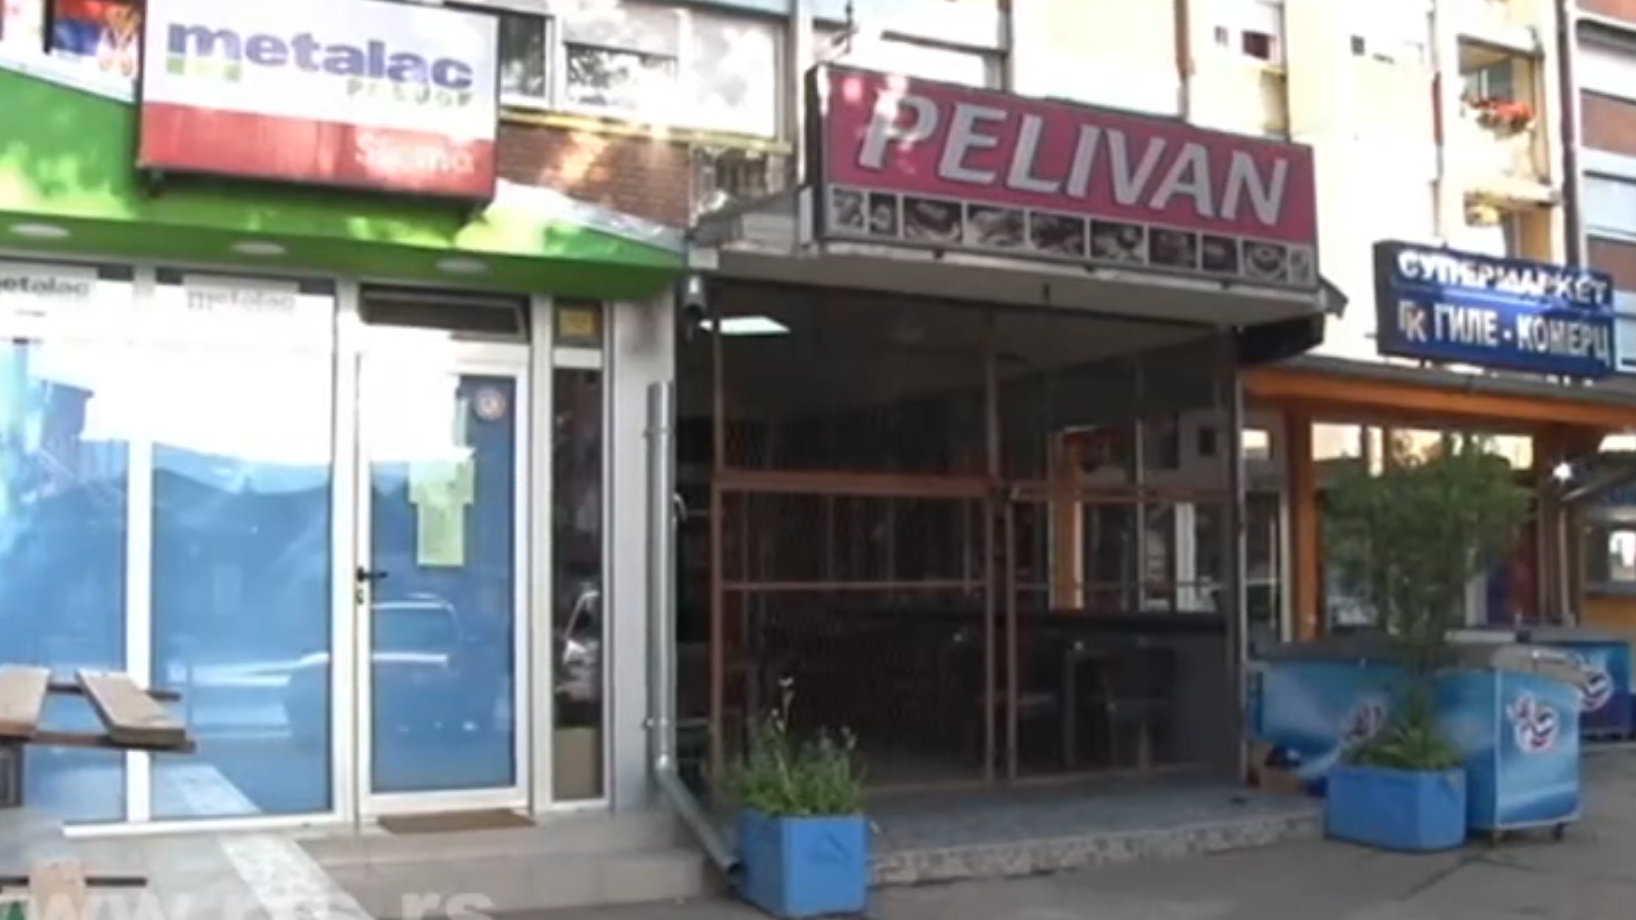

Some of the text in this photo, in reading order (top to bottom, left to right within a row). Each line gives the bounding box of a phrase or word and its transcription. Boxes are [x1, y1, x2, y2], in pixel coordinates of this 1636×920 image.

[167, 22, 474, 90] metalac
[858, 95, 1288, 226] PELIVAN
[0, 274, 90, 297] etalac
[1397, 250, 1608, 305] СУПЕРМАРКЕТ
[1433, 302, 1499, 347] ГИЛЕ
